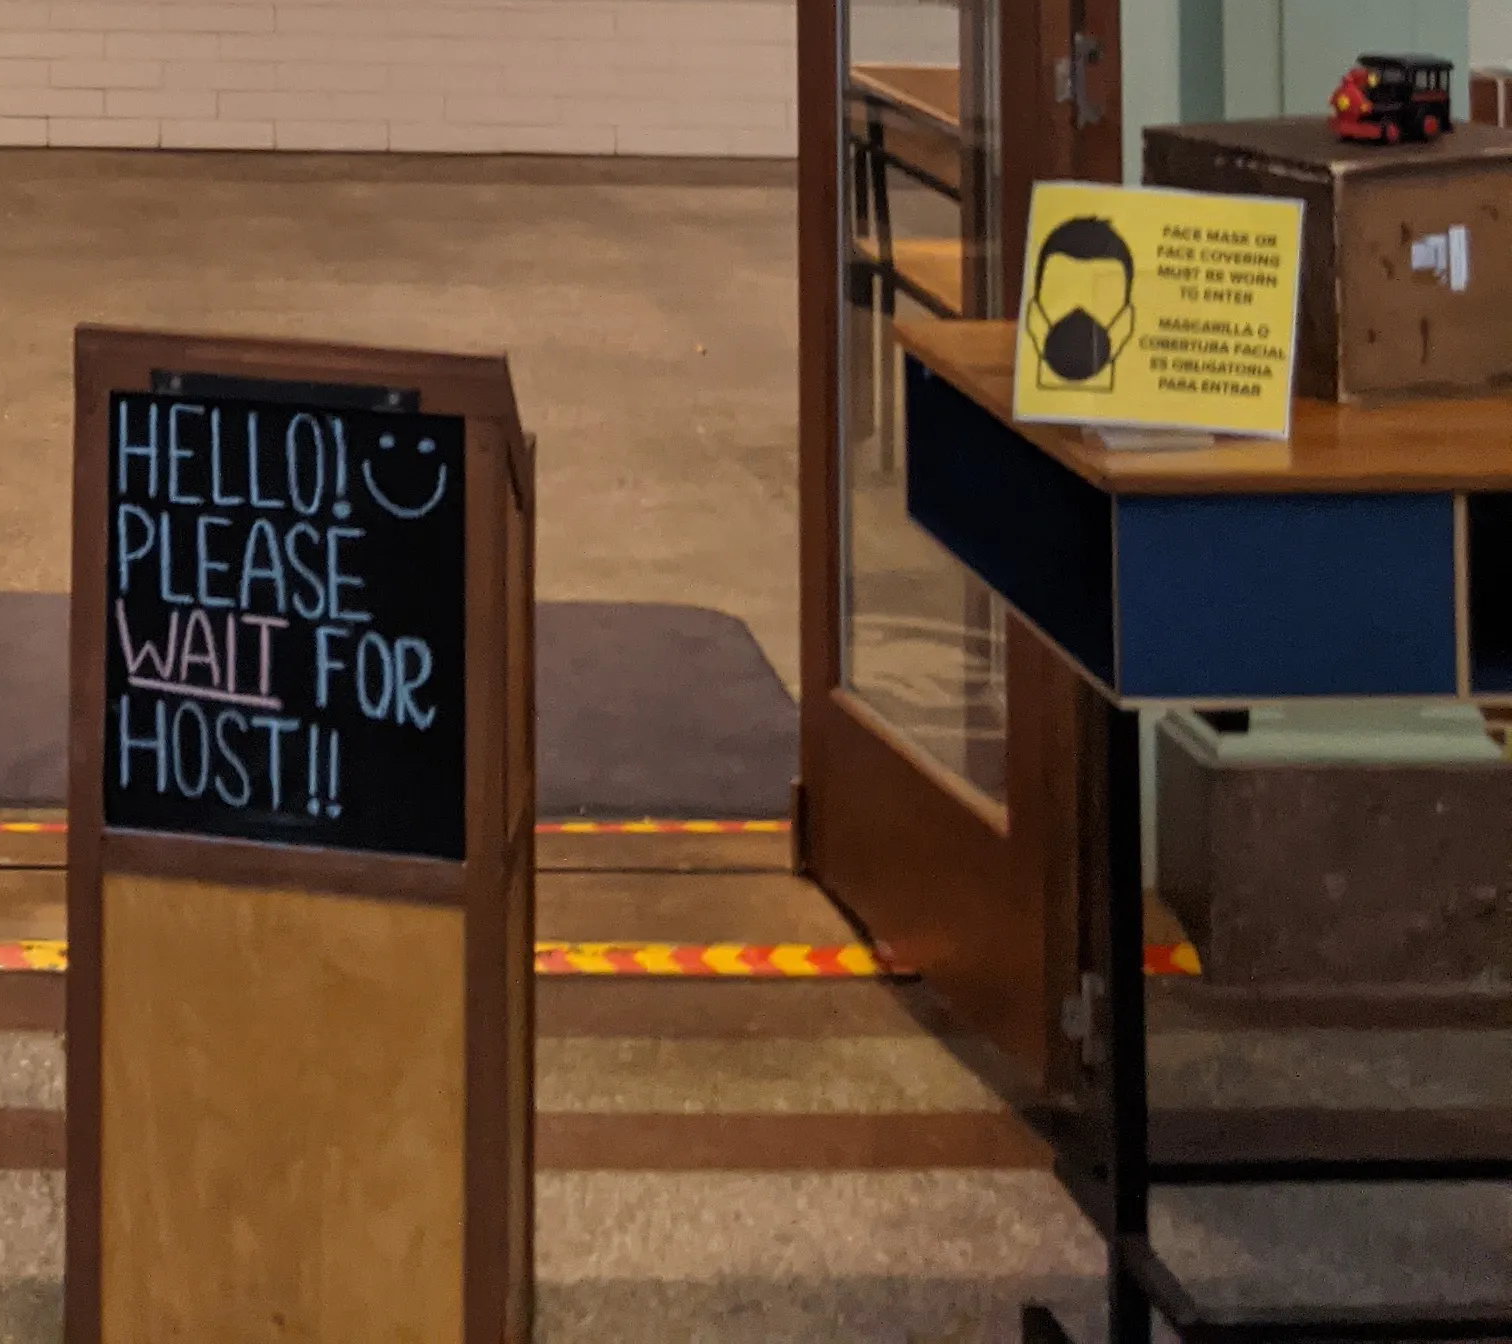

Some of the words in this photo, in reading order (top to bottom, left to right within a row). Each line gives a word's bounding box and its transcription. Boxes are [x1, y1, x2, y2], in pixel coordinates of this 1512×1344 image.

[1162, 224, 1202, 243] FACE
[1206, 229, 1250, 246] MASK
[1254, 233, 1277, 248] OR
[1156, 244, 1196, 261] FACE
[1200, 248, 1280, 268] COVERING
[1157, 264, 1200, 281] MUST
[1229, 271, 1277, 288] WORN
[1179, 286, 1200, 303] TO
[1203, 288, 1254, 306] ENTER
[1158, 317, 1254, 337] MASCARILLA
[1138, 335, 1229, 356] COBERTURA
[1233, 344, 1286, 361] FACIAL
[1158, 377, 1197, 393] PARA
[1201, 379, 1261, 398] ENTRAR
[118, 400, 351, 520] HELLO!
[117, 502, 373, 624] PLEASE
[115, 598, 290, 700] WAIT
[315, 625, 437, 732] FOR
[118, 694, 342, 819] HOST!!
